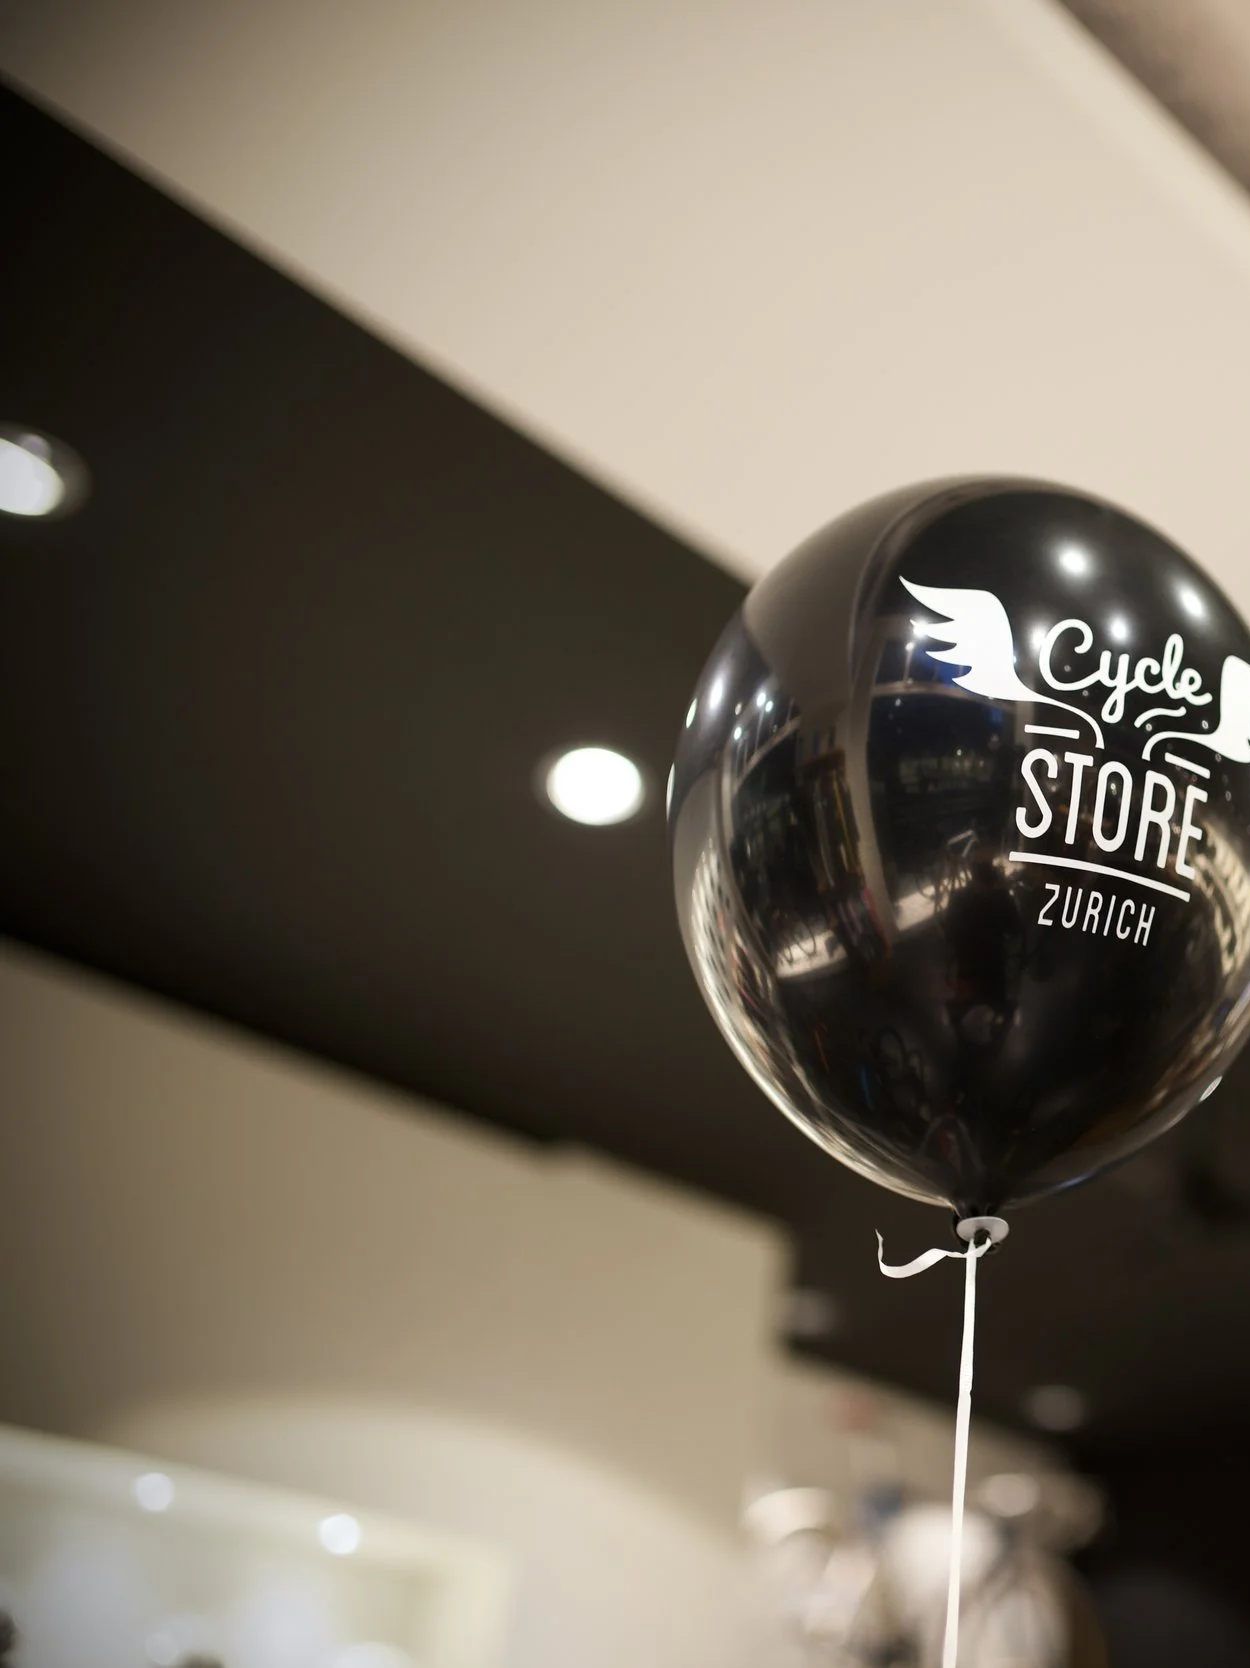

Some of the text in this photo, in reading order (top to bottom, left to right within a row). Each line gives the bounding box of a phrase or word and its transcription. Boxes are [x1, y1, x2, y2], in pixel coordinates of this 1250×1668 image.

[1040, 619, 1213, 723] Cycle
[1015, 748, 1208, 879] STORE
[1037, 883, 1155, 946] ZURICH
